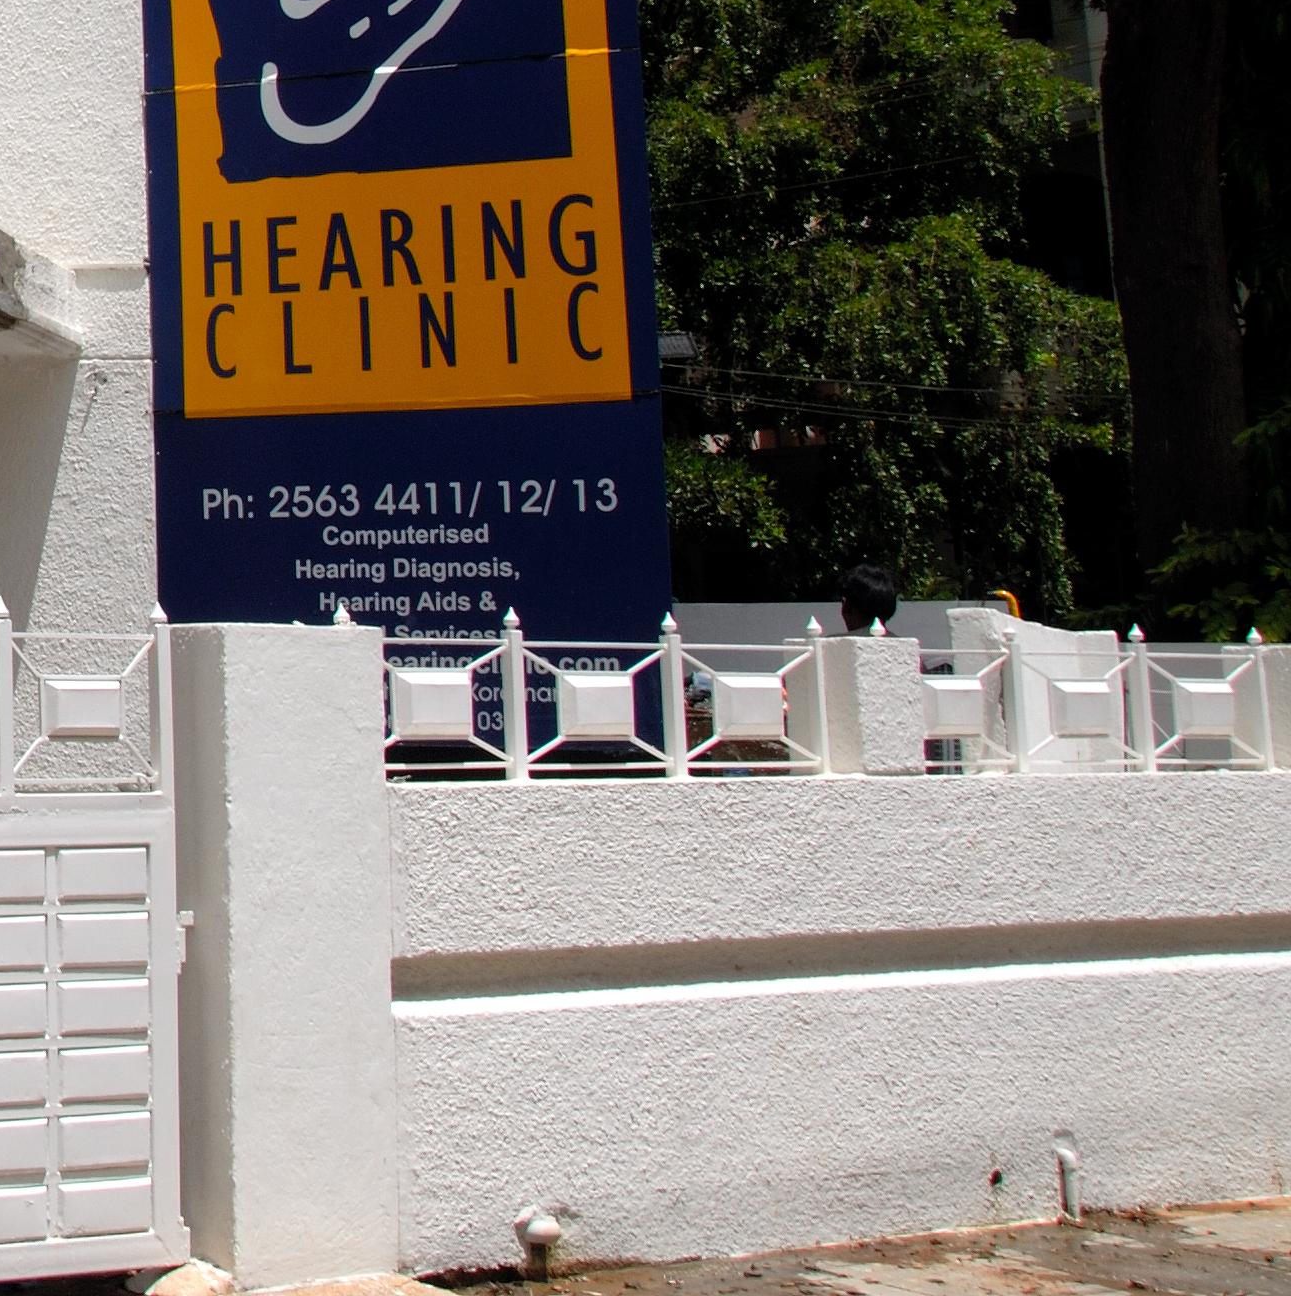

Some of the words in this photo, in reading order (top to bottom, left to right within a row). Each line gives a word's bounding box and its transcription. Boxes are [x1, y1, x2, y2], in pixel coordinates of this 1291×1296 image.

[202, 193, 599, 298] HEARING
[205, 281, 603, 379] CLINIC
[202, 487, 255, 520] Ph:
[269, 484, 361, 519] 2563
[571, 477, 619, 514] 13
[321, 523, 490, 549] Computerised
[294, 558, 387, 583] Hearing
[392, 557, 521, 583] Diagnosis,
[416, 590, 473, 612] Aids
[478, 591, 498, 612] &
